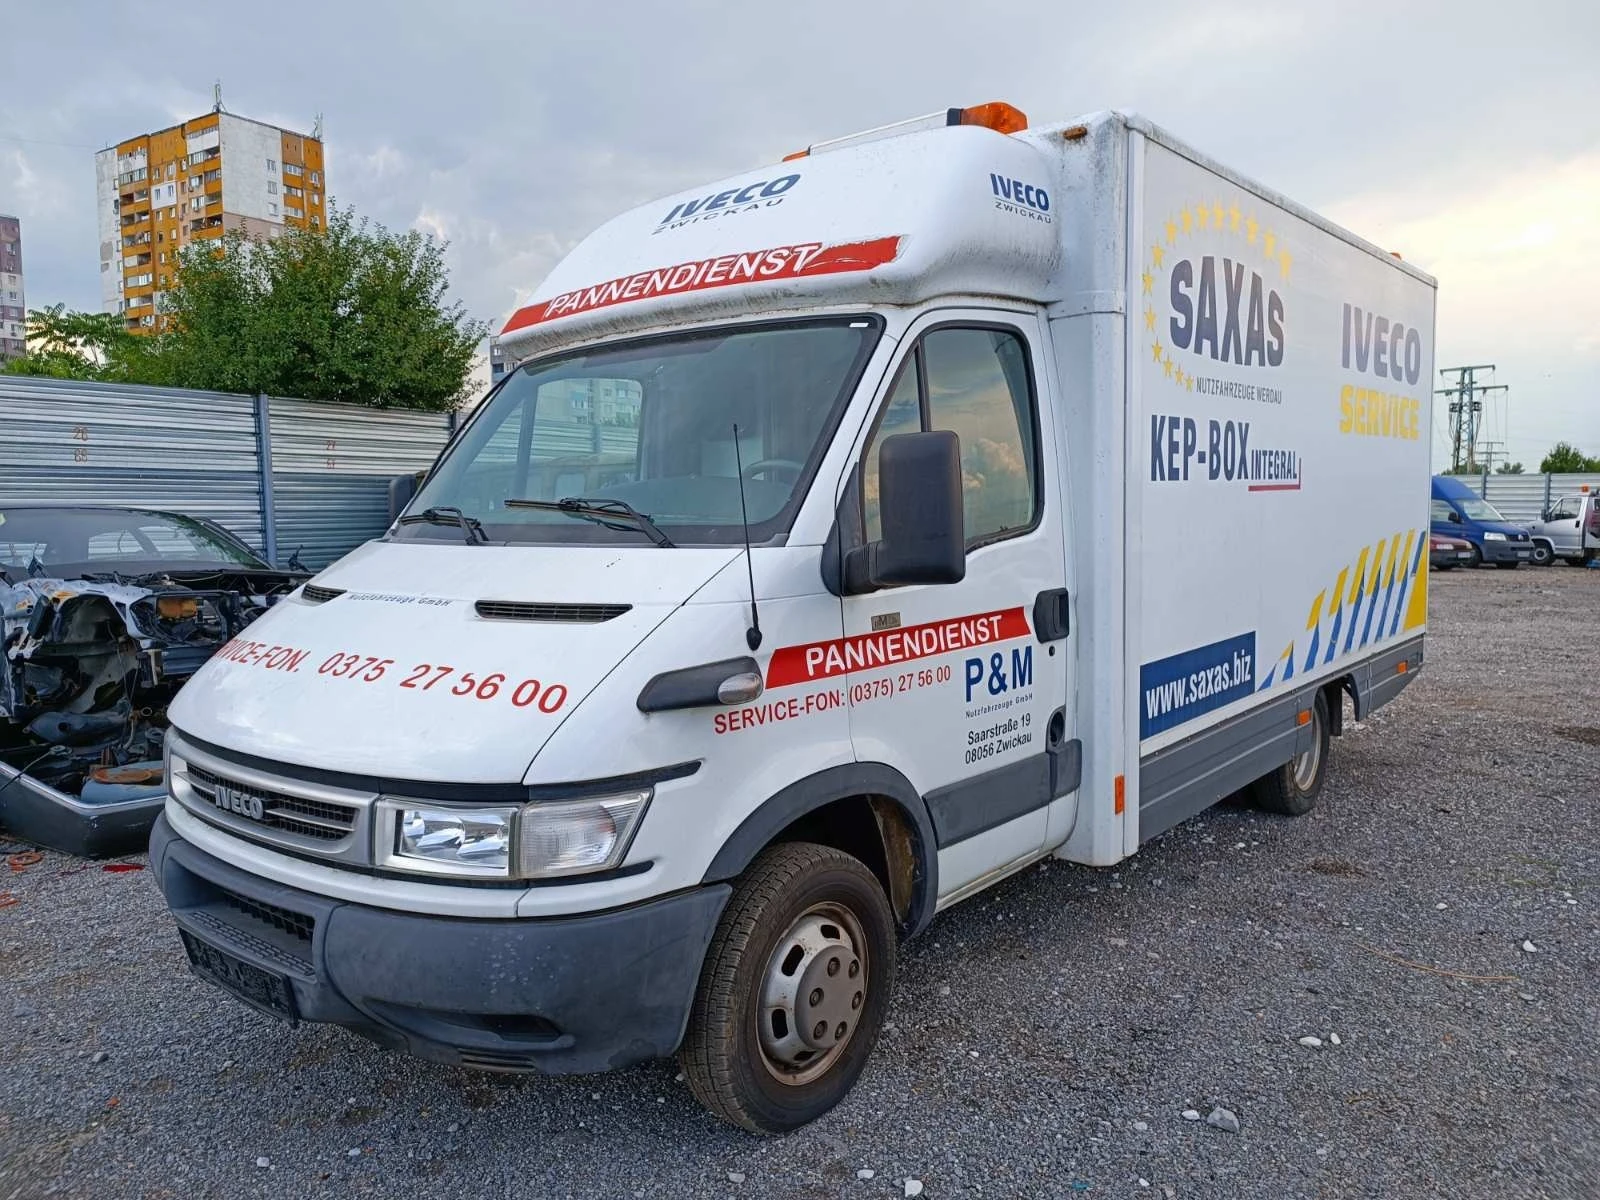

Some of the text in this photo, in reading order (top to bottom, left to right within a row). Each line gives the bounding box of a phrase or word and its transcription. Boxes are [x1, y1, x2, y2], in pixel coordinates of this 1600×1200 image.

[651, 198, 784, 235] ZWICKAU
[661, 174, 801, 224] IVECO
[990, 173, 1049, 211] IVECO
[995, 201, 1051, 224] ZWICKAU
[545, 245, 820, 318] PANNENDIENST
[1170, 256, 1284, 367] SAXAS
[1342, 302, 1420, 386] IVECO
[1196, 377, 1282, 404] NUTZFAHRZEUGE WERDAU
[1339, 384, 1419, 440] SERVICE
[1151, 415, 1297, 481] KEP-BOX INTEGRAL
[806, 615, 1003, 677] PANNENDIENST
[965, 645, 1033, 702] P&M
[318, 653, 395, 682] 0375
[400, 664, 454, 690] 27
[451, 673, 505, 700] 56
[511, 679, 567, 713] 00
[714, 665, 951, 735] SERVICE-FON: (0375) 27 56 00
[965, 692, 1033, 719] Nutzfahrzeuge GmbH
[1146, 649, 1251, 720] www.saxas.biz
[965, 731, 1032, 764] 08056 Zwickau
[967, 713, 1031, 745] Saarstraße 19
[215, 784, 263, 820] IVECO
